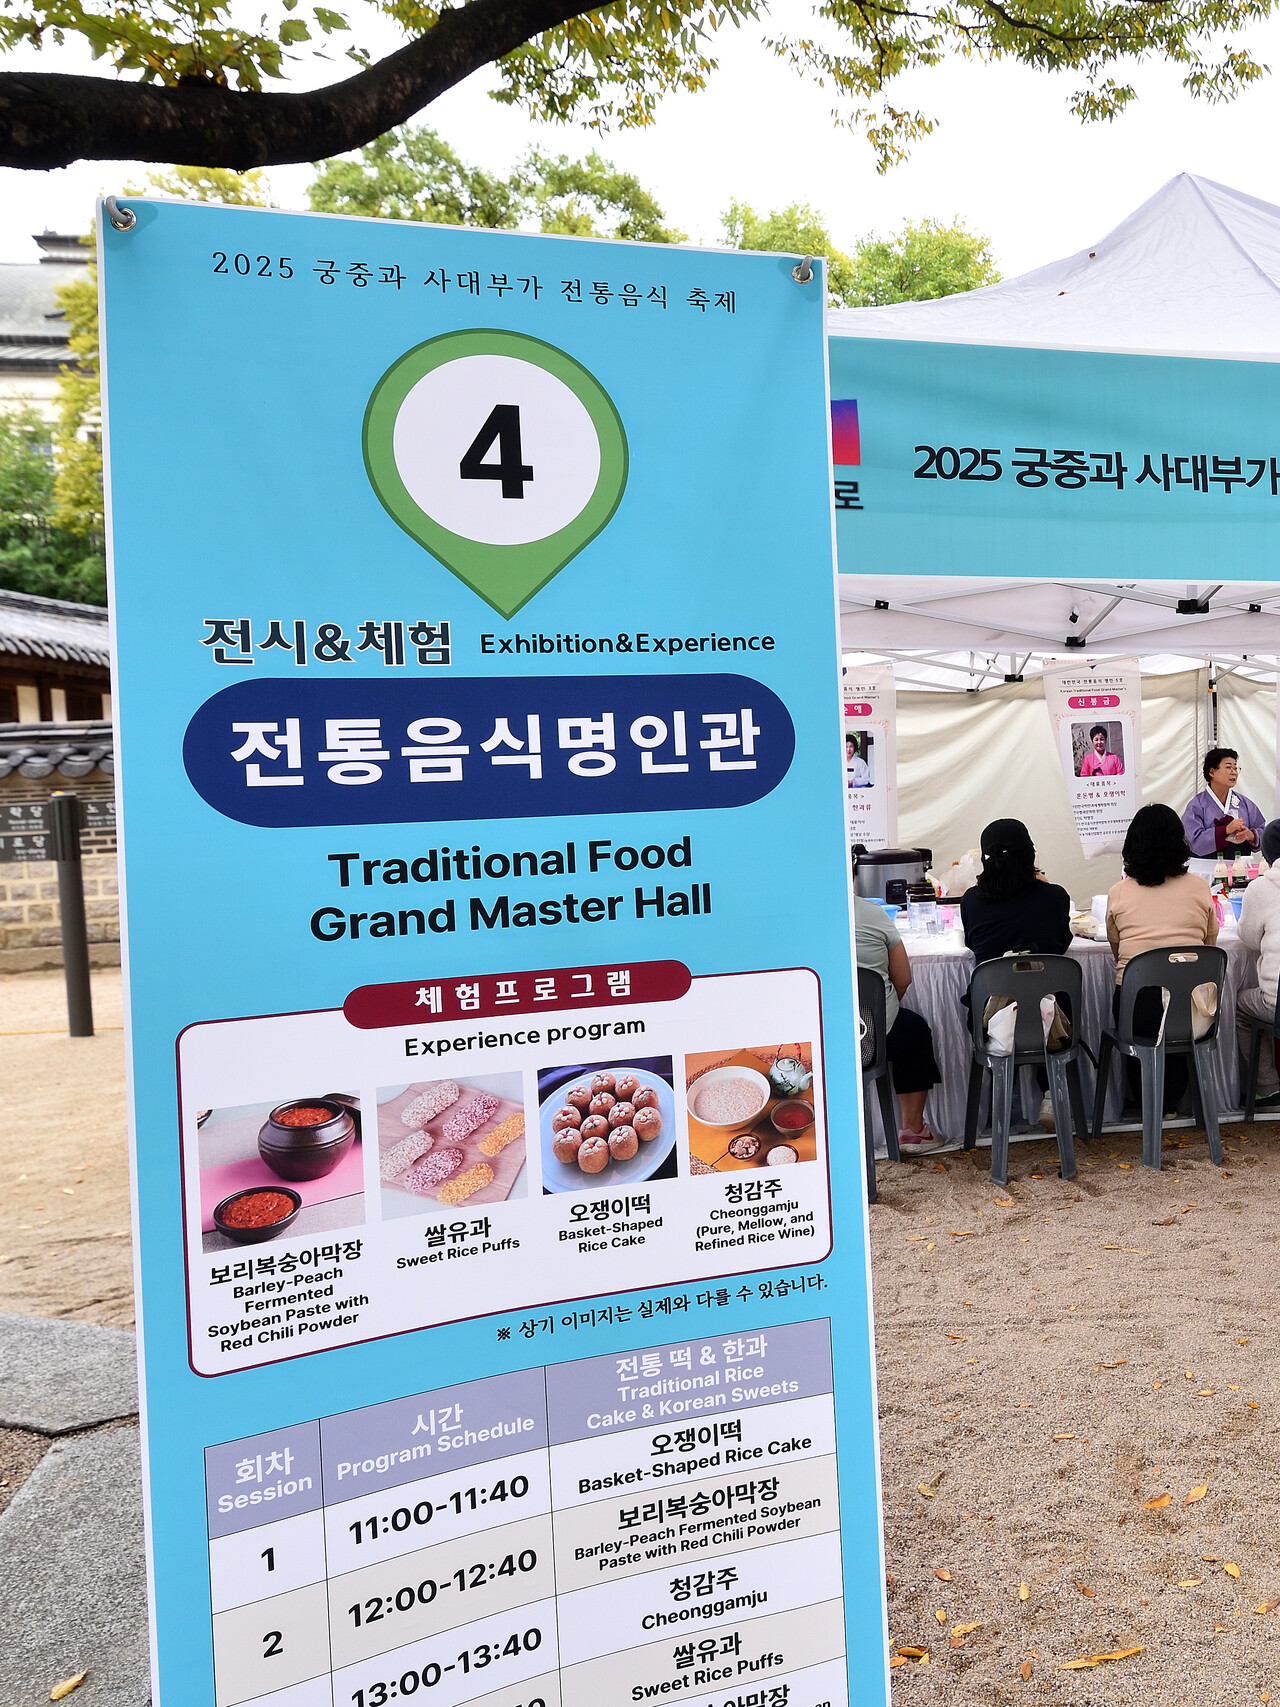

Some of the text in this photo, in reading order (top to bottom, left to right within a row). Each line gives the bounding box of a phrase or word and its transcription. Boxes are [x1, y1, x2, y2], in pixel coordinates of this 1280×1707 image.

[211, 251, 737, 314] 2025 궁중과 사대부가 전통음식 축제
[459, 404, 534, 499] 4
[913, 444, 1002, 482] 2025
[1010, 446, 1128, 491] 궁중과
[201, 618, 452, 666] 전시&체험
[480, 630, 776, 656] Exhibition&Experience
[230, 709, 762, 788] 전통음식명인관
[328, 835, 694, 888] Traditional Food
[309, 883, 713, 942] Grand Master Hall
[414, 969, 632, 1015] 체험프로그램
[405, 1017, 646, 1058] Experience program
[568, 1192, 652, 1224] 오쟁이떡
[709, 1199, 800, 1224] Cheonggamju
[724, 1177, 784, 1204] 청감주
[424, 1215, 493, 1247] 쌀유과
[558, 1215, 664, 1243] Basket-Shaped
[578, 1231, 647, 1254] Rice Cake
[695, 1209, 815, 1242] (Pure, Mellow, and
[695, 1221, 816, 1252] Refined Rice Wine)
[209, 1238, 364, 1288] 보리복숭아막장
[396, 1236, 521, 1273] Sweet Rice Puffs
[233, 1265, 344, 1300] Barley-Peach
[244, 1284, 334, 1314] Fermented
[207, 1292, 370, 1342] Soybean Paste with
[518, 1313, 556, 1341] 상기
[561, 1302, 633, 1334] 이미지는
[637, 1292, 692, 1321] 실제와
[695, 1286, 733, 1312] 다를
[735, 1282, 754, 1305] 수
[756, 1271, 829, 1304] 있습니다.
[219, 1311, 360, 1354] Red Chili Powder
[615, 1335, 769, 1383] 전통 떡 & 한과
[586, 1376, 800, 1431] Cake & Korean Sweets
[617, 1362, 765, 1404] Traditional Rice
[411, 1402, 465, 1440] 시간
[649, 1419, 744, 1459] 오쟁이떡
[234, 1446, 296, 1486] 회차
[336, 1415, 536, 1484] Program Schedule
[578, 1433, 813, 1496] Basket-Shaped Rice Cake
[217, 1473, 314, 1516] Session
[616, 1475, 781, 1531] 보리복숭아막장
[260, 1473, 531, 1574] 1 11:00-11:40
[574, 1495, 822, 1563] Barley-Peach Fermented Soybean
[598, 1514, 803, 1572] Paste with Red Chili Powder
[262, 1548, 539, 1659] 2 12:00-12:40
[668, 1566, 742, 1603] 청감주
[641, 1587, 770, 1631] Cheonggamju
[351, 1627, 543, 1707] 13:00-13:40
[672, 1632, 743, 1669] 쌀유과
[631, 1674, 690, 1701] Sweet
[694, 1666, 733, 1686] Rice
[737, 1652, 785, 1675] Puffs
